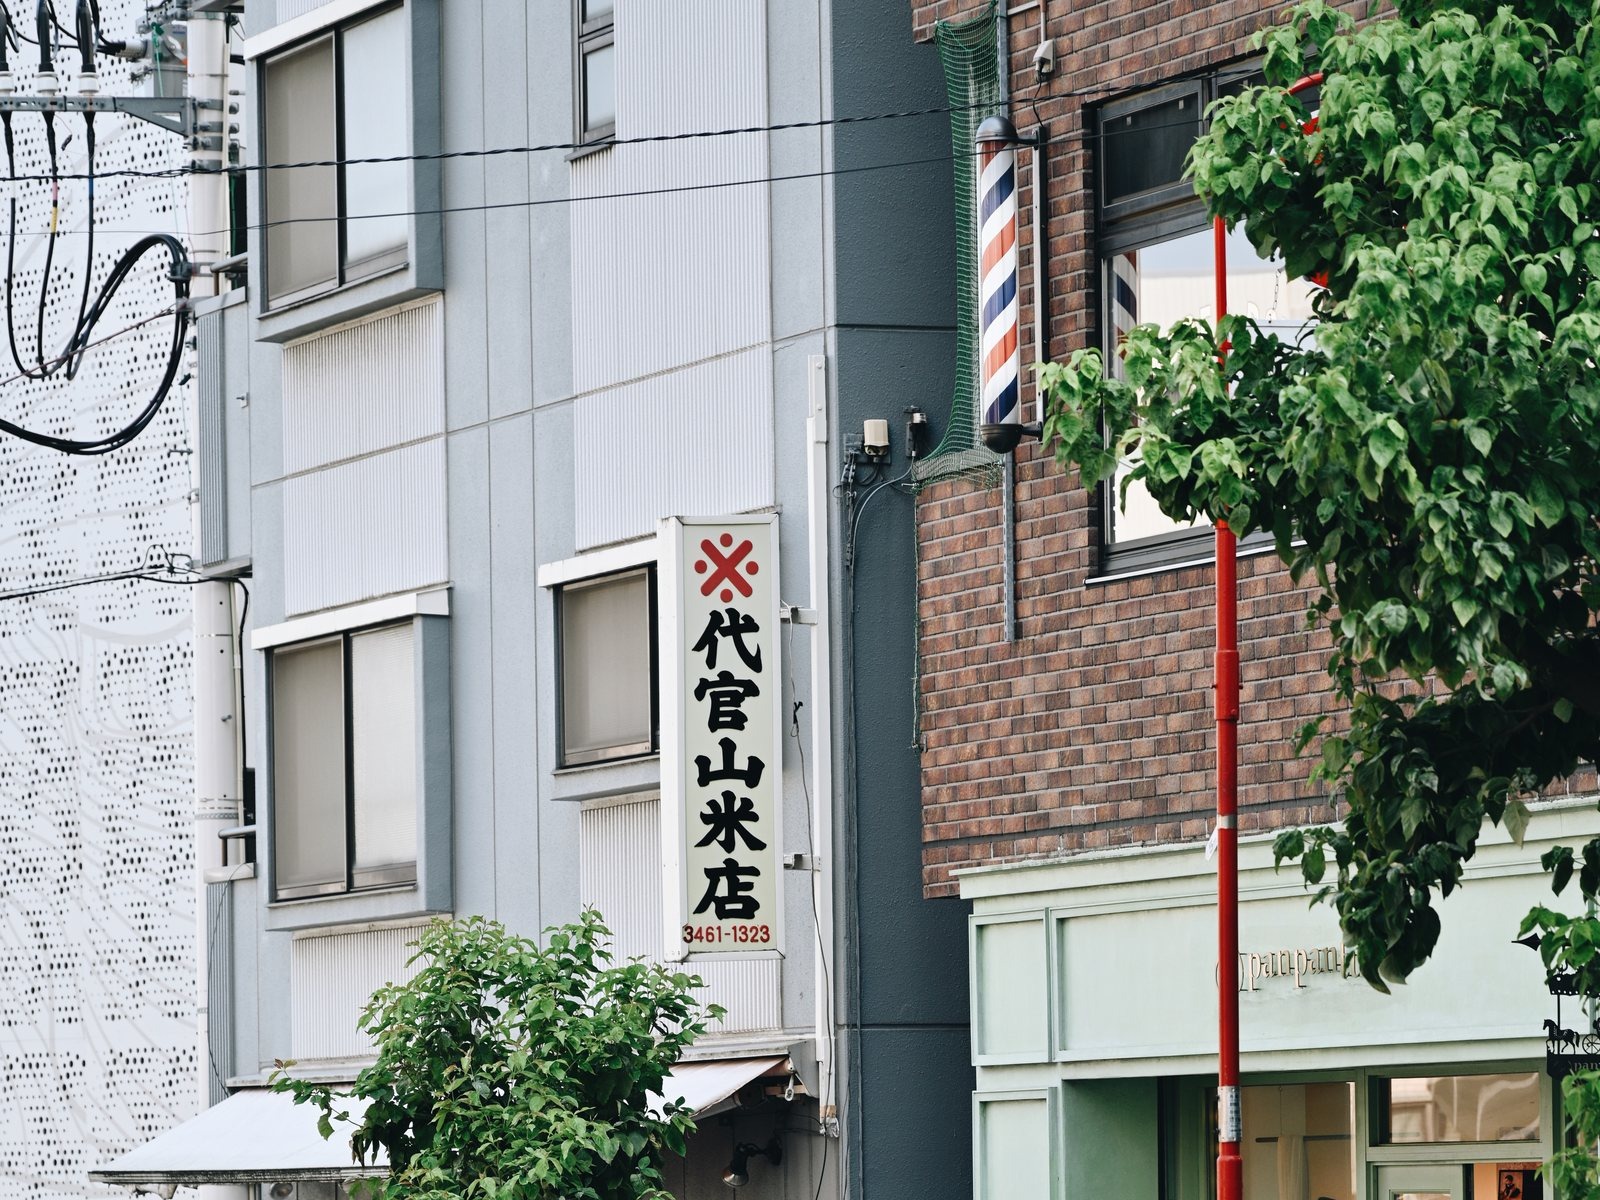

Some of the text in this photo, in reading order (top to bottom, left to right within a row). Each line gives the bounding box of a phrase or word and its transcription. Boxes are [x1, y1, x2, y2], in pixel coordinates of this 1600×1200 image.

[692, 608, 767, 920] 代官山米店
[683, 923, 771, 944] 3461-1323
